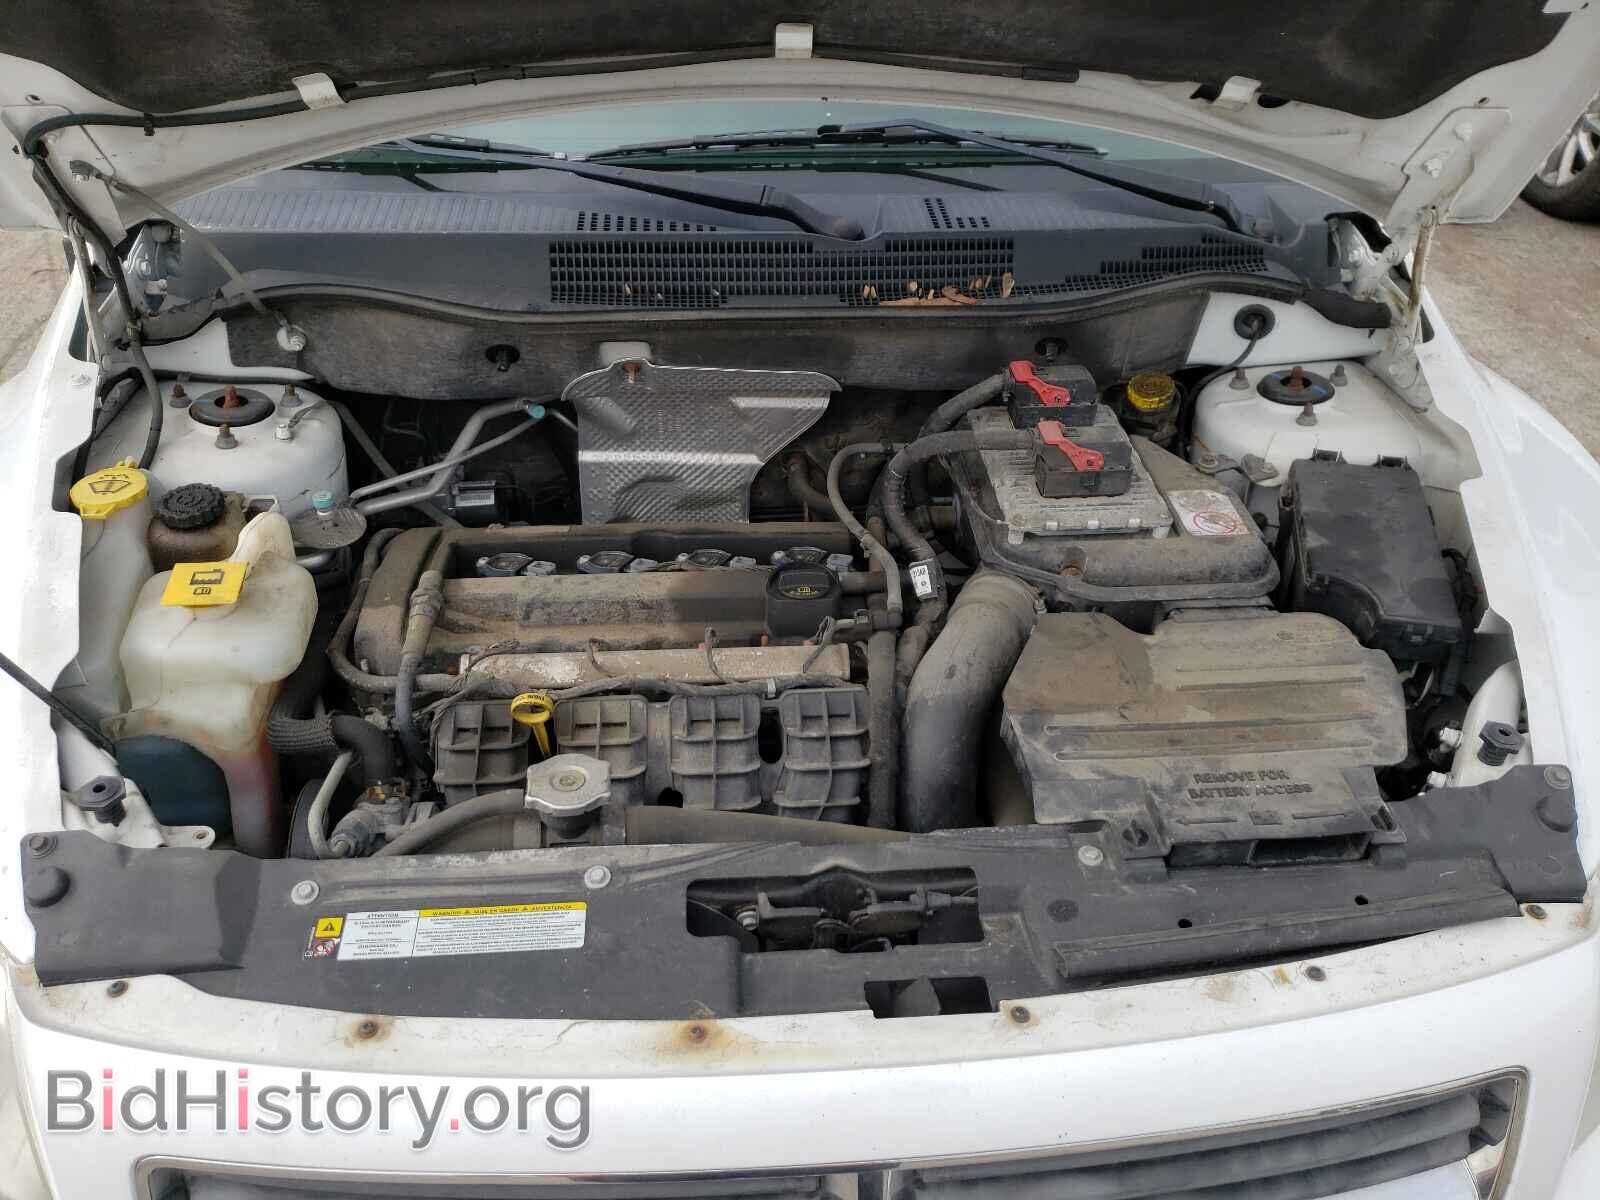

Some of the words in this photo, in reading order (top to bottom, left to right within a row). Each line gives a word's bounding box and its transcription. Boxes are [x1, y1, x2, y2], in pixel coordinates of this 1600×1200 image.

[1192, 772, 1257, 784] REMOVE
[1259, 770, 1290, 781] FOR
[1187, 786, 1250, 799] BATTERY
[1255, 783, 1313, 796] ACCESS
